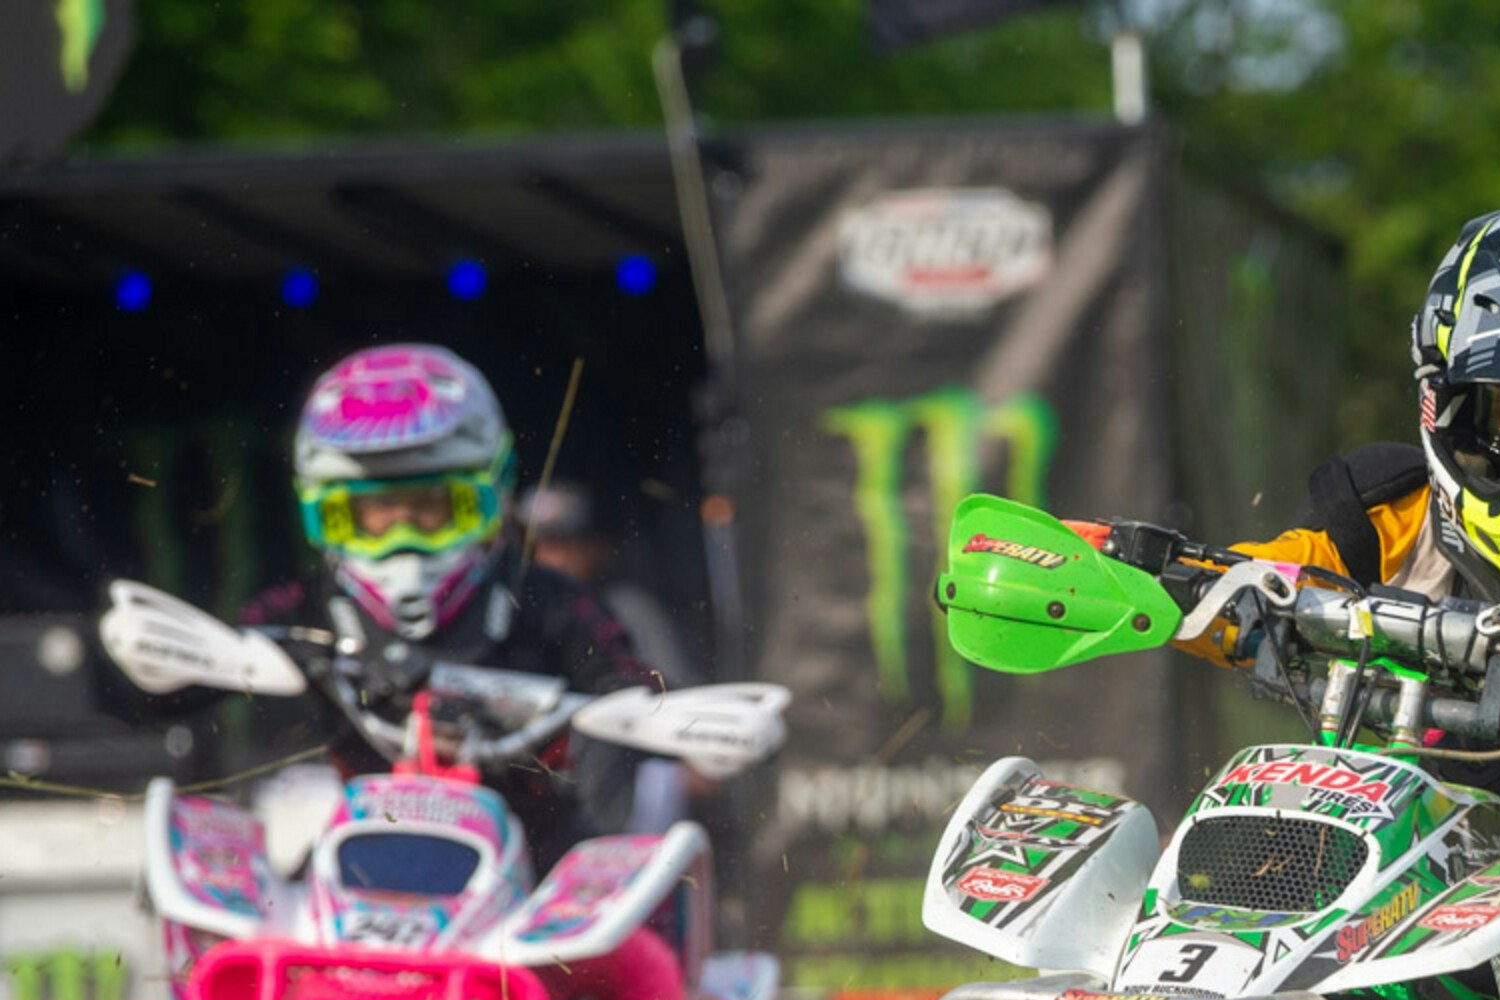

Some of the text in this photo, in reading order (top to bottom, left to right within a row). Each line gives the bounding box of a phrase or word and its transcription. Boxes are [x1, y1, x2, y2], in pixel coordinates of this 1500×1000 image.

[1218, 761, 1391, 804] KENDA
[1308, 786, 1377, 814] TIRES
[1335, 880, 1421, 962] SUPERATV
[1157, 943, 1219, 983] 3
